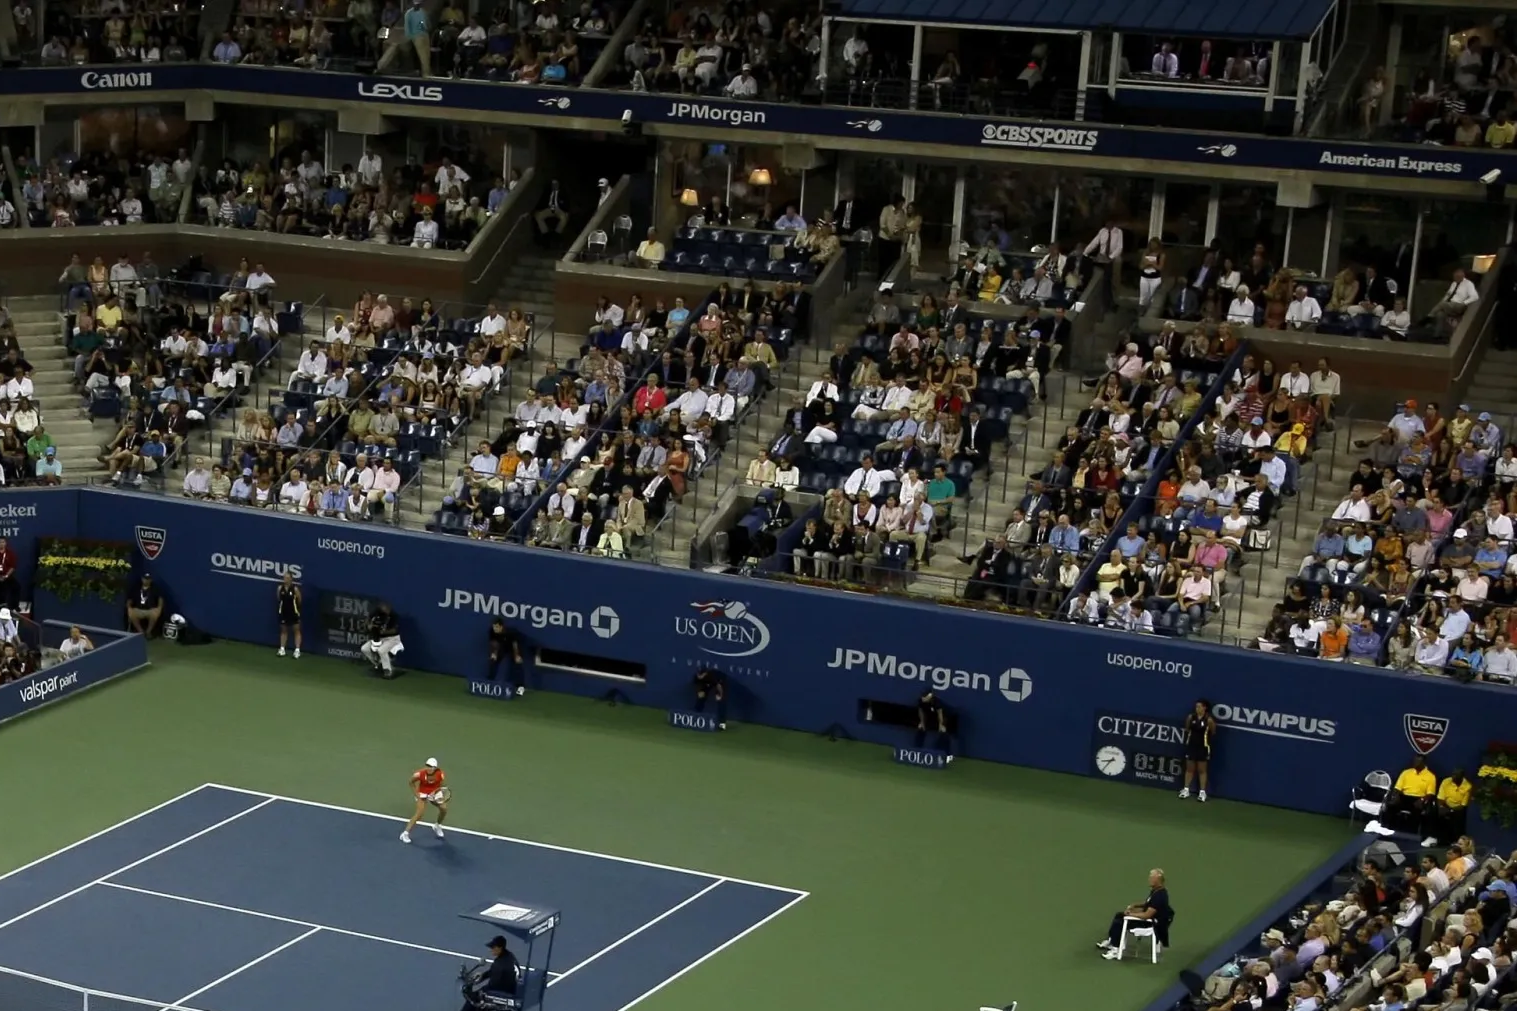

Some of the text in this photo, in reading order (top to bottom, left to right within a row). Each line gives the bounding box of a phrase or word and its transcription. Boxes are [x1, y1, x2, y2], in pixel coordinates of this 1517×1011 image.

[80, 71, 152, 89] Canon
[358, 81, 443, 101] LEXUS
[667, 102, 766, 125] JPMorgan
[1319, 151, 1462, 173] American Express
[141, 531, 164, 540] USTA
[317, 538, 385, 559] usopen.org
[211, 552, 303, 579] OLYMPUS
[334, 596, 370, 616] IBM
[438, 588, 583, 629] JPMorgan
[675, 616, 756, 645] US OPEN
[827, 647, 991, 691] JPMorgan
[1107, 653, 1192, 678] usopen.org
[19, 671, 78, 702] valspar paint
[472, 681, 502, 697] POLO
[673, 712, 706, 728] POLO
[1098, 716, 1188, 744] CITIZEN
[1212, 703, 1336, 737] OLYMPUS
[1412, 719, 1444, 732] USTA
[899, 749, 934, 765] POLO
